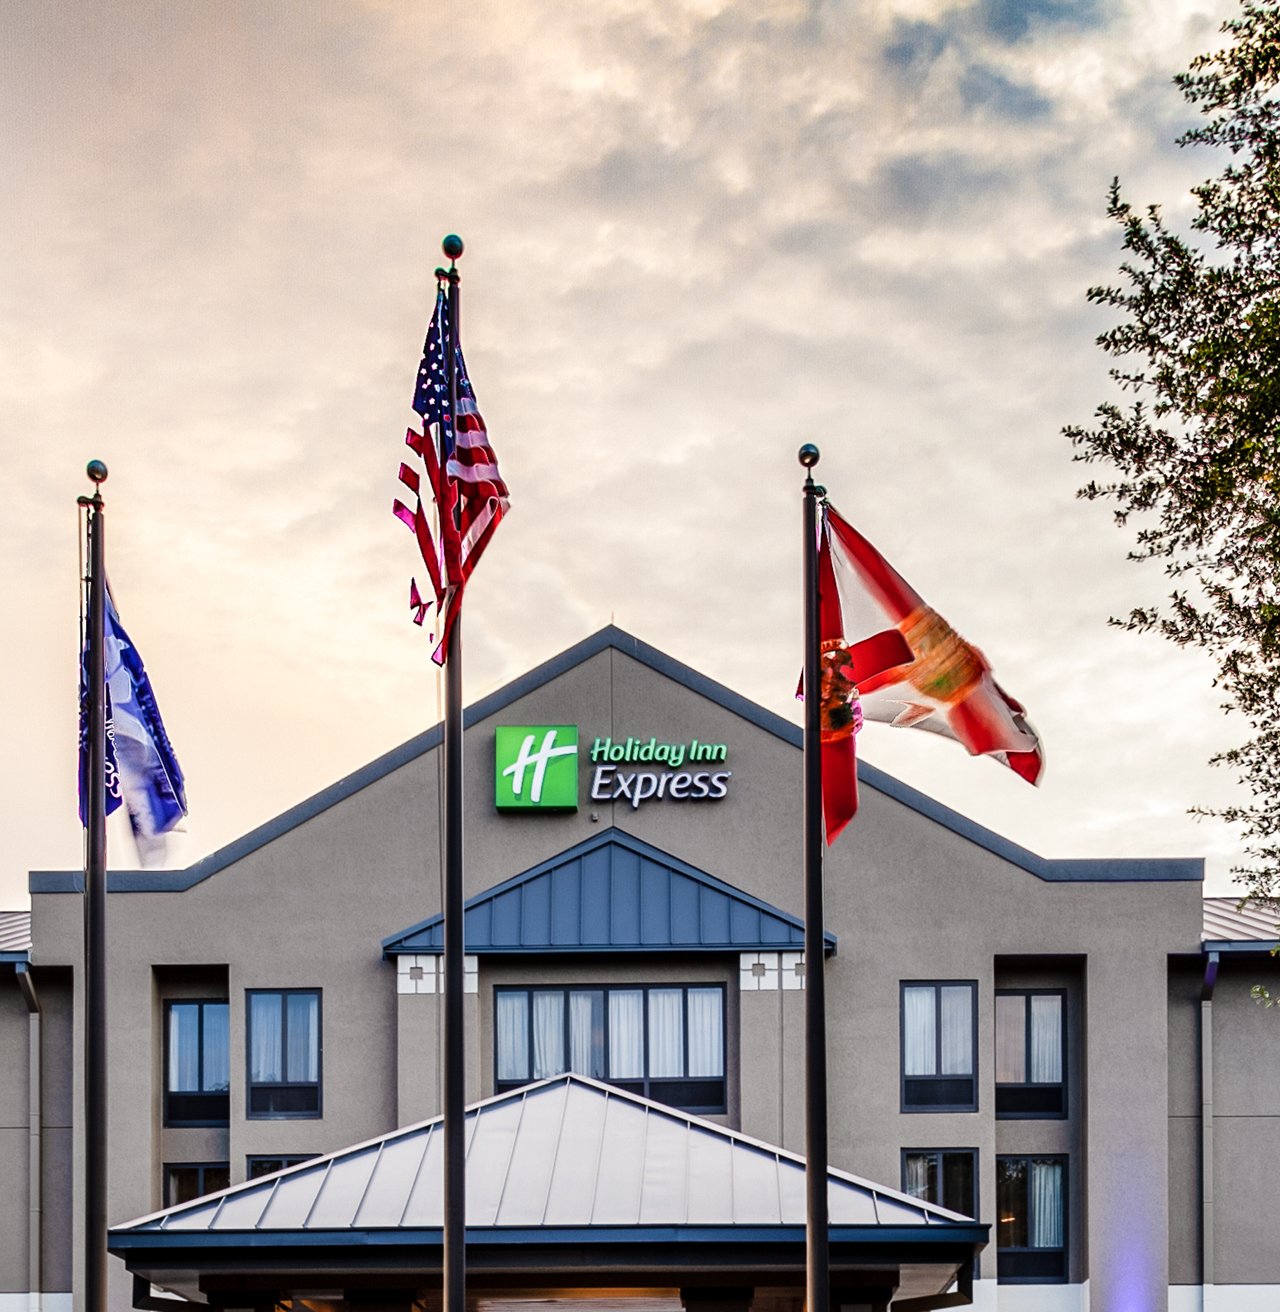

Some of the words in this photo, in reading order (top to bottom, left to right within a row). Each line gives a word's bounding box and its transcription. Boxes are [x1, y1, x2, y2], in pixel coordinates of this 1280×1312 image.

[503, 730, 577, 802] H
[591, 737, 684, 767] Holiday
[688, 740, 727, 761] Inn
[591, 765, 728, 809] Express
